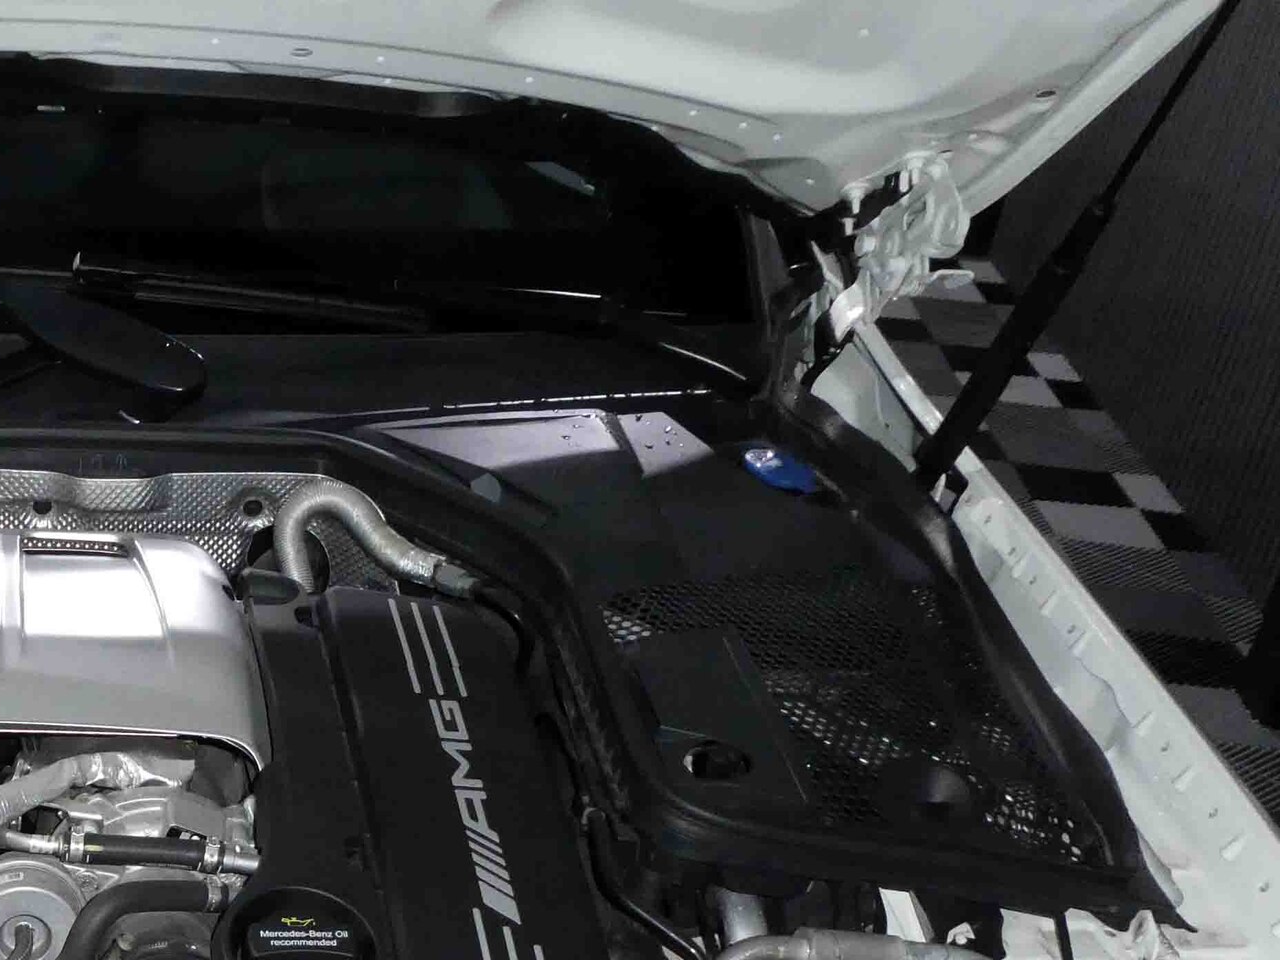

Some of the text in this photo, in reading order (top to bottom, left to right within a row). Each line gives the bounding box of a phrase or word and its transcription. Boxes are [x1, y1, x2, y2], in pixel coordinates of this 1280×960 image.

[428, 699, 501, 848] AMG
[260, 930, 348, 938] Mercedes-Benz Oil
